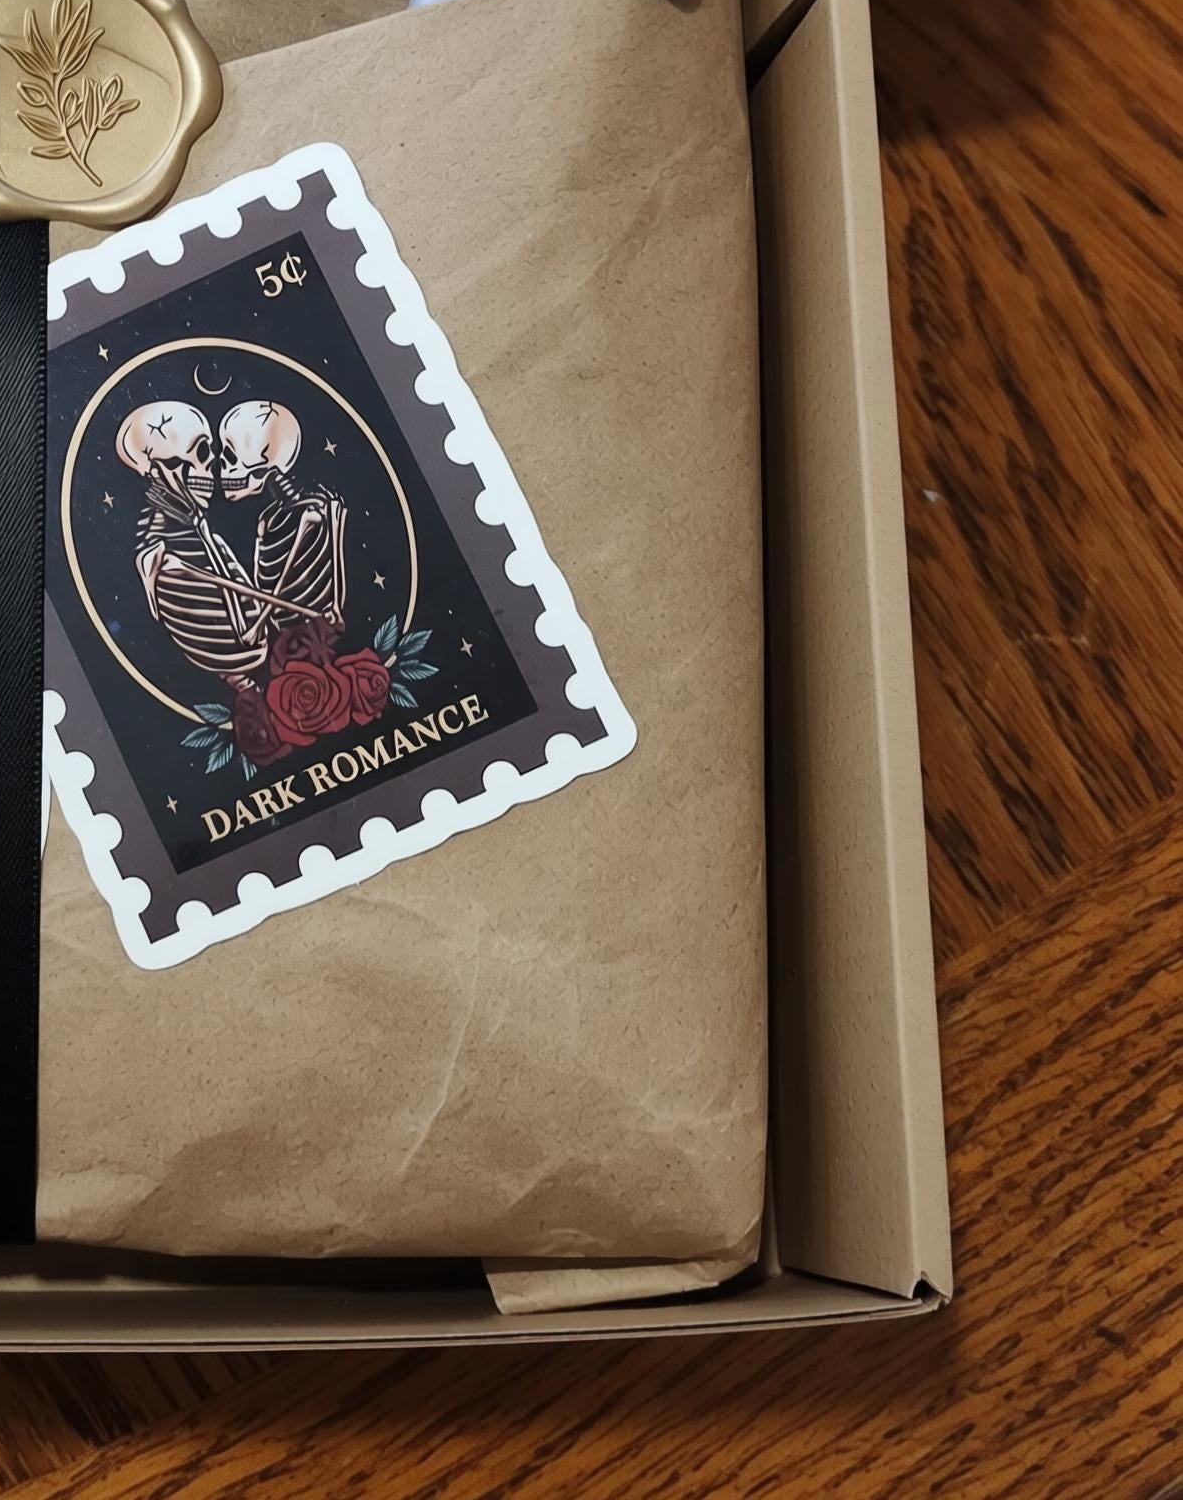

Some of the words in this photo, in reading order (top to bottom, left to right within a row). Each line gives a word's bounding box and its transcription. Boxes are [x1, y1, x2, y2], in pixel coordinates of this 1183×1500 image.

[256, 251, 308, 299] 5¢
[201, 774, 306, 843] DARK
[311, 692, 490, 797] ROMANCE
